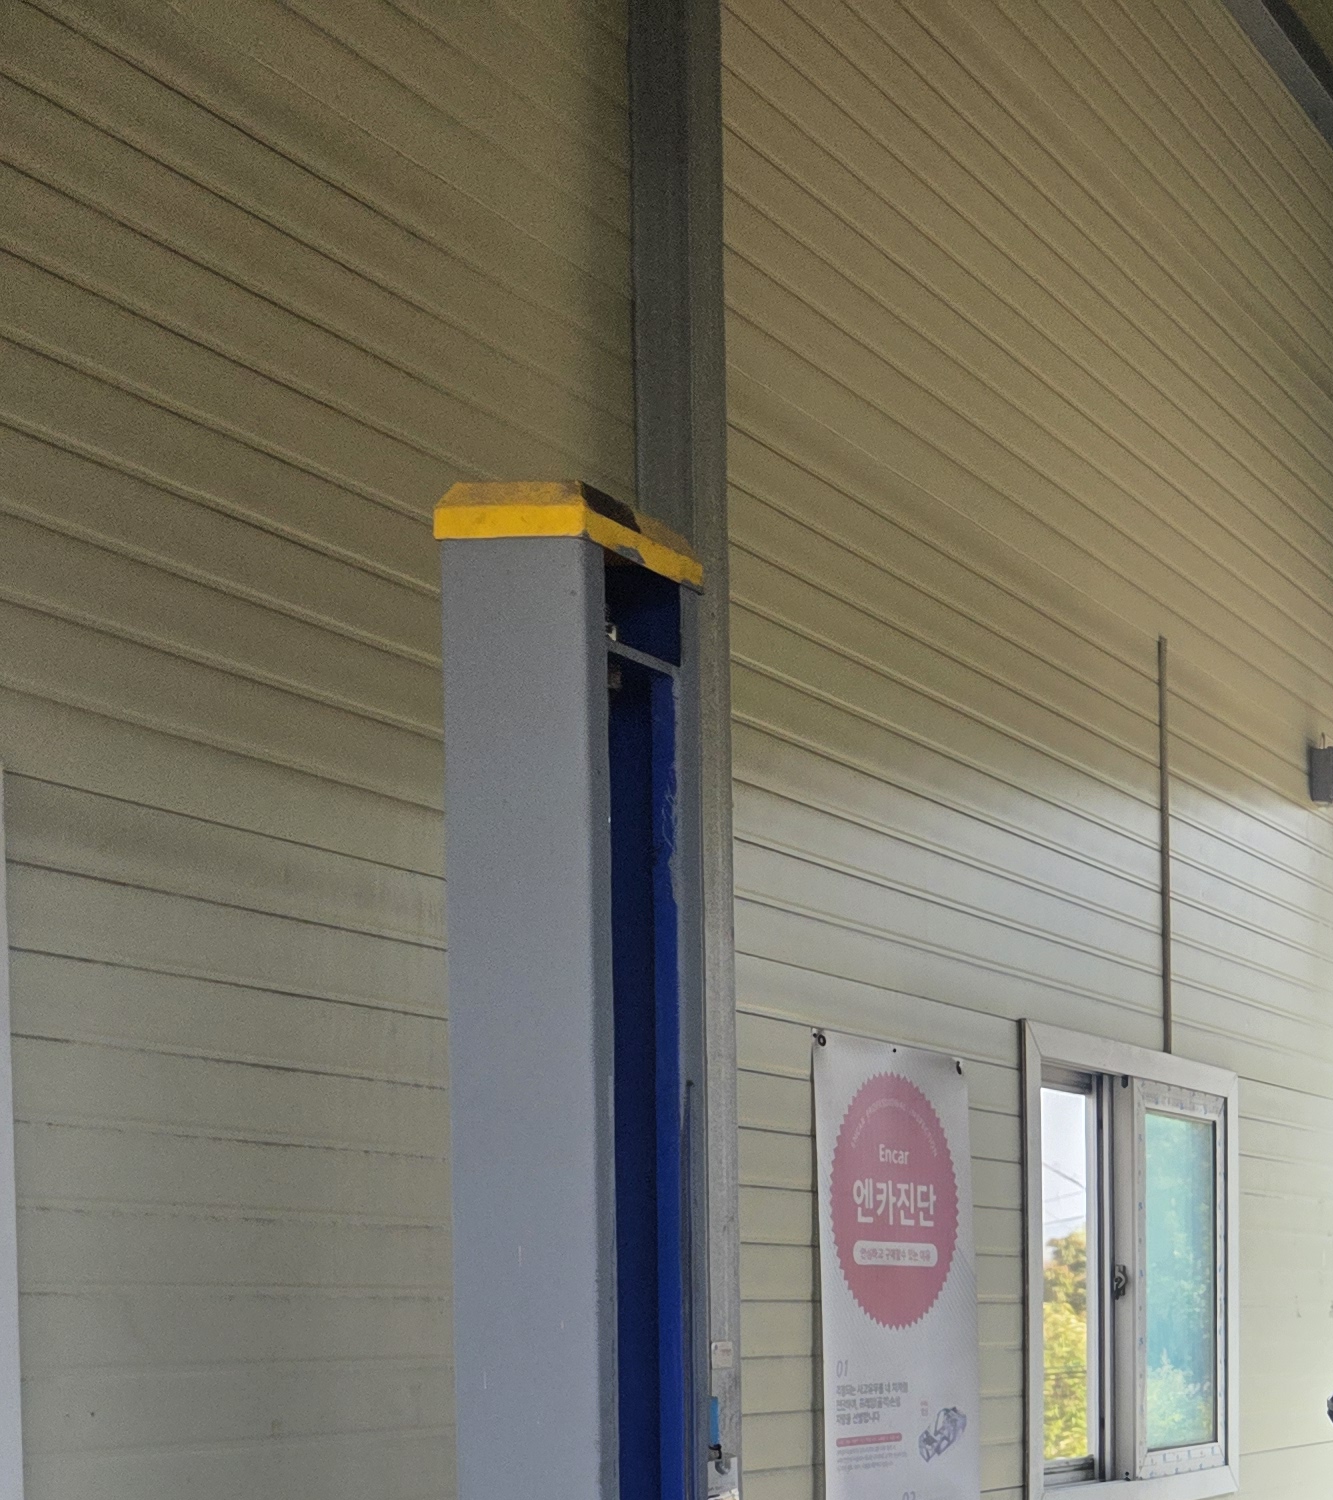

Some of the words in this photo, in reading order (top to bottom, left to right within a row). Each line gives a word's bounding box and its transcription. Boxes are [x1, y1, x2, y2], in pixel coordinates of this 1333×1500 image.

[879, 1144, 910, 1165] Encar
[852, 1177, 937, 1228] 엔카진단
[836, 1359, 848, 1378] 01
